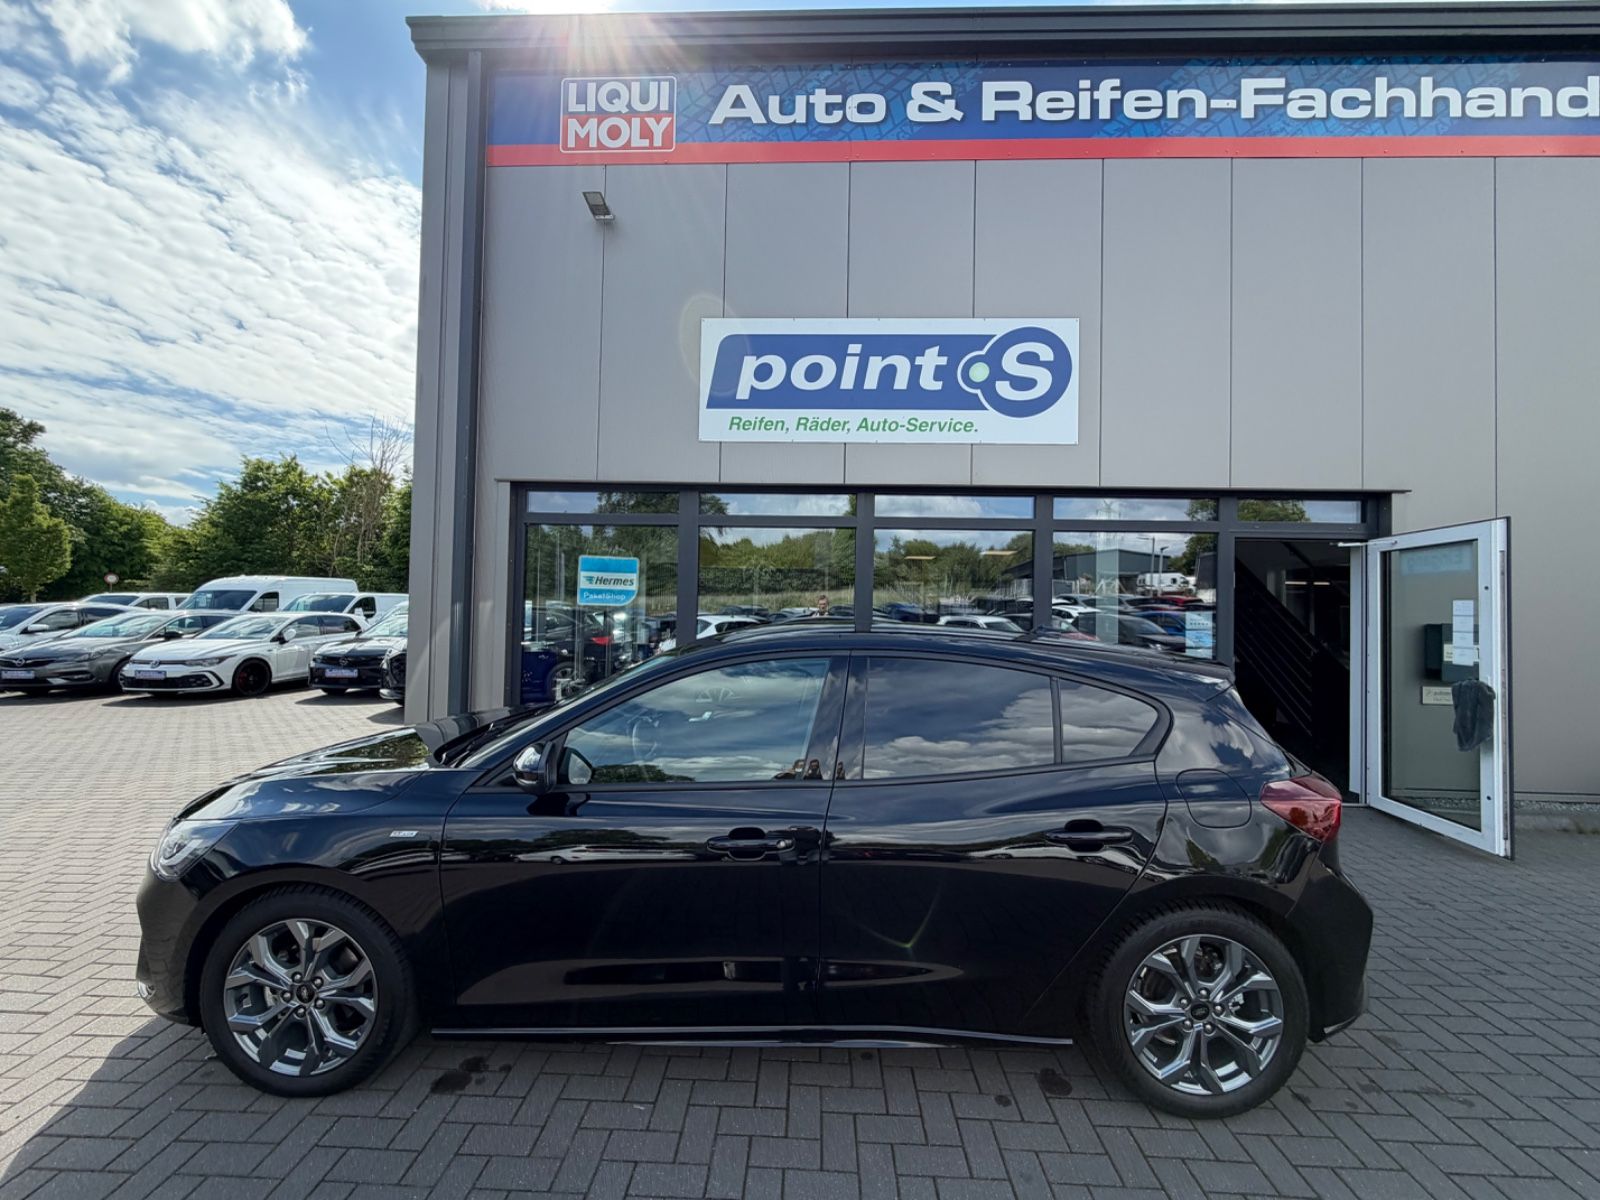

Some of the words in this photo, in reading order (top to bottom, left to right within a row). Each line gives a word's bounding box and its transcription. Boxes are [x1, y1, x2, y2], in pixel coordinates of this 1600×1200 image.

[567, 81, 670, 114] LIQUI
[708, 83, 887, 124] Auto
[905, 81, 964, 122] &
[981, 75, 1600, 122] Reifen-Fachhand
[567, 116, 673, 149] MOLY
[735, 343, 948, 400] point
[995, 341, 1055, 402] S
[728, 416, 790, 434] Reifen,
[795, 416, 852, 435] Räder,
[856, 416, 979, 434] Auto-Service.
[595, 576, 634, 586] Hermes
